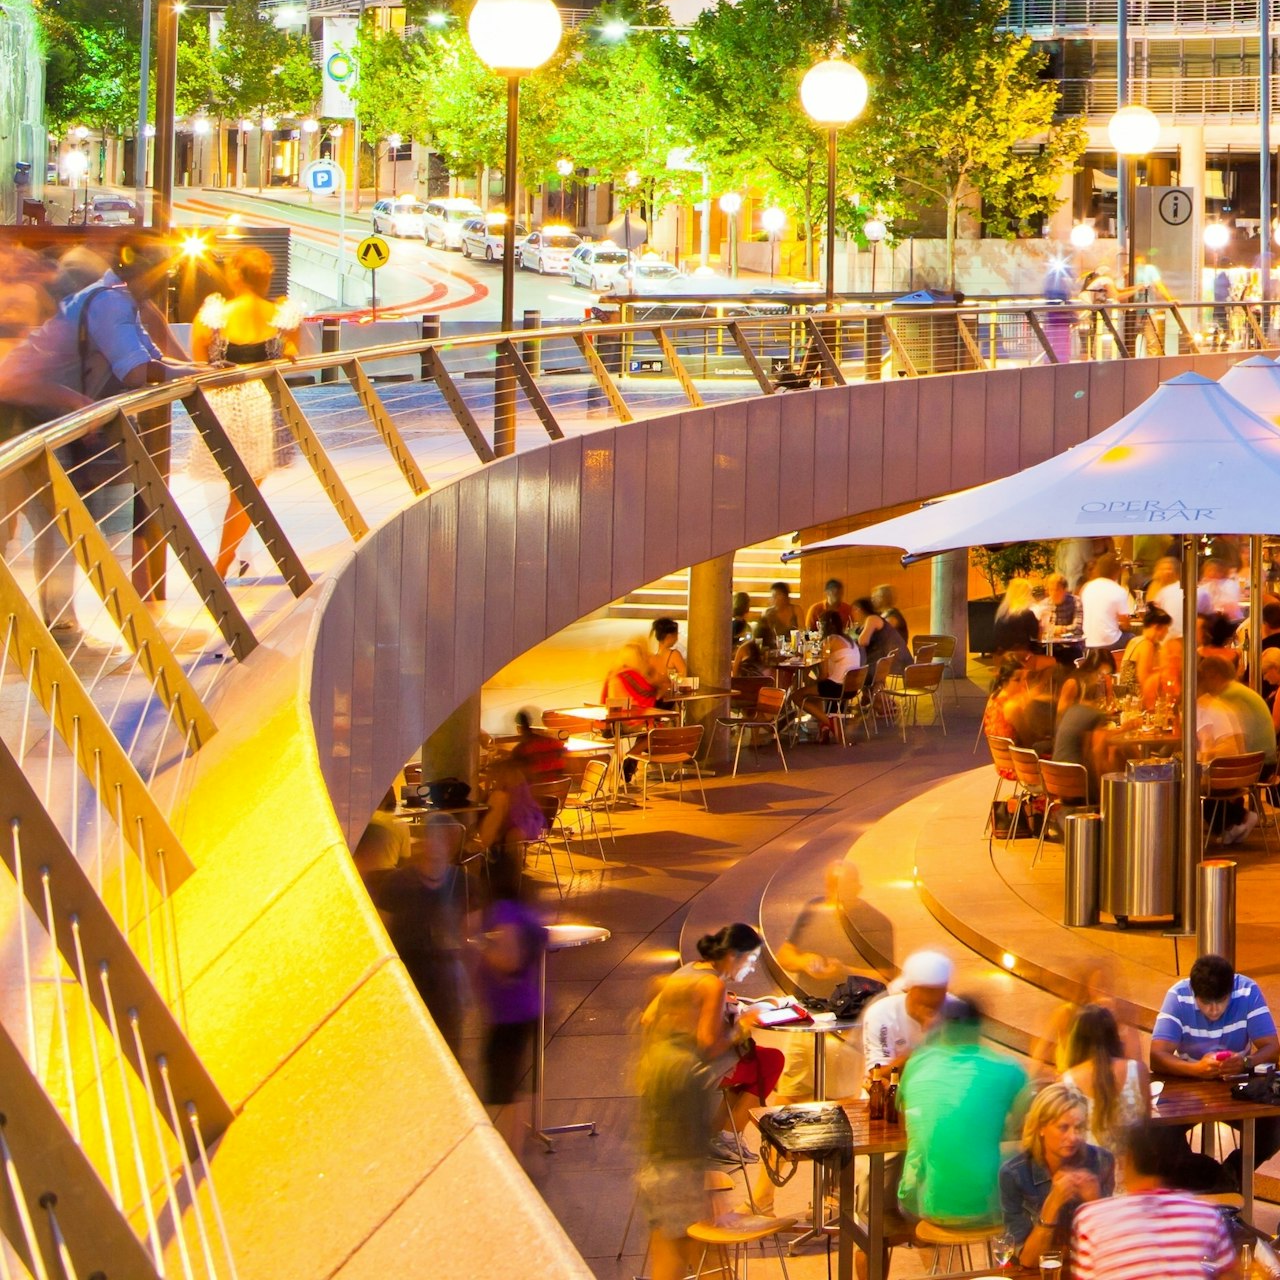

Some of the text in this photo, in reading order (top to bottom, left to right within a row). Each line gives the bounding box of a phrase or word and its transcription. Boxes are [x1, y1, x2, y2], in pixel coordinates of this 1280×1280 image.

[316, 172, 329, 186] P
[1080, 499, 1188, 513] OPERA
[1147, 508, 1217, 522] BAR
